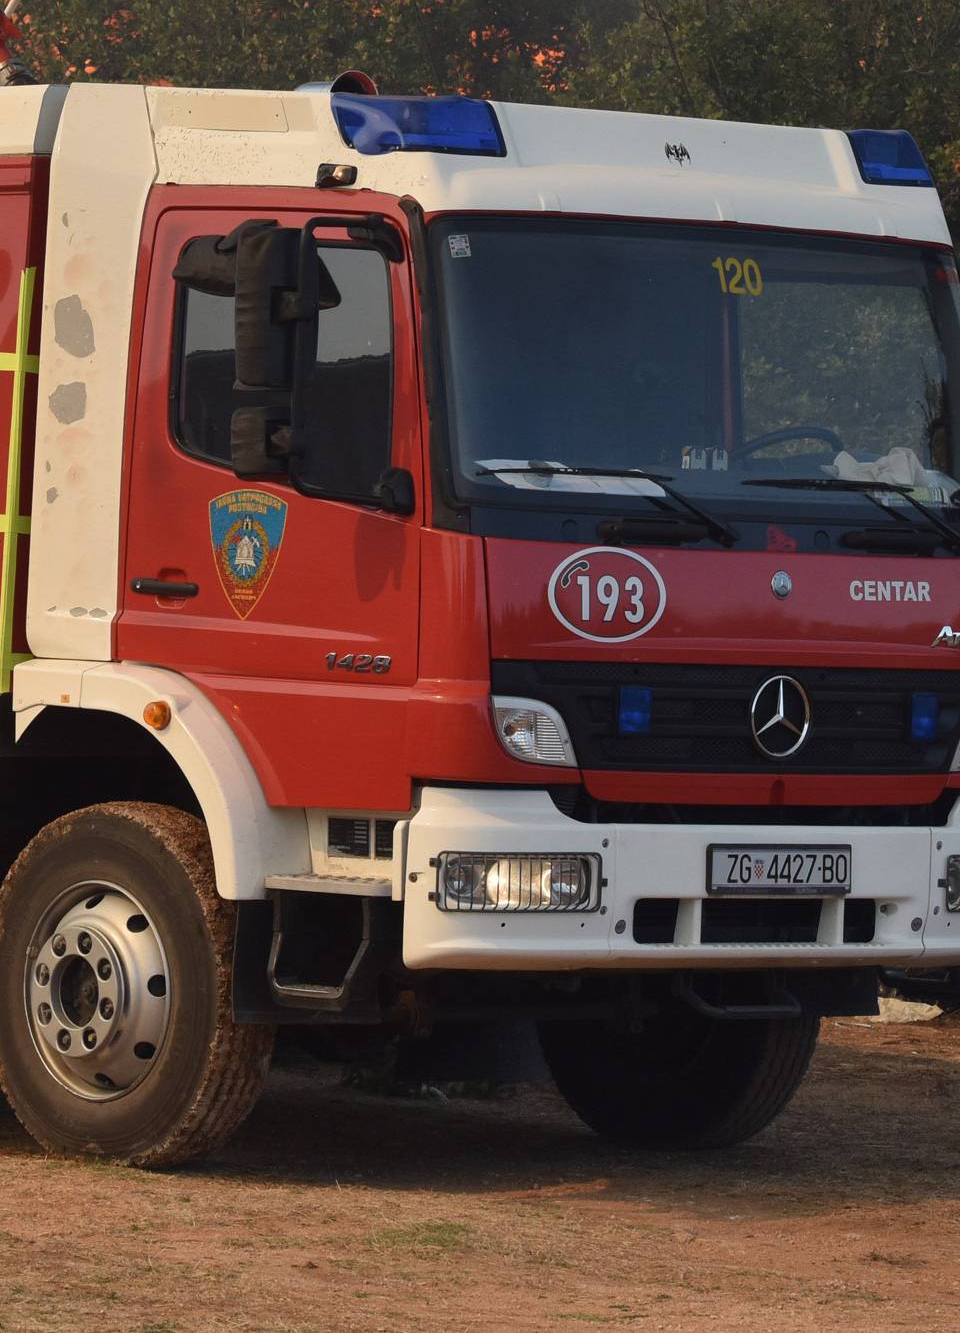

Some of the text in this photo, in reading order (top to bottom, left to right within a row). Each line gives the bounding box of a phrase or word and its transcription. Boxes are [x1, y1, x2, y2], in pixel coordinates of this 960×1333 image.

[712, 256, 763, 296] 120
[577, 575, 645, 624] 193
[849, 580, 932, 602] CENTAR
[325, 652, 391, 674] 1428
[727, 854, 752, 884] ZG
